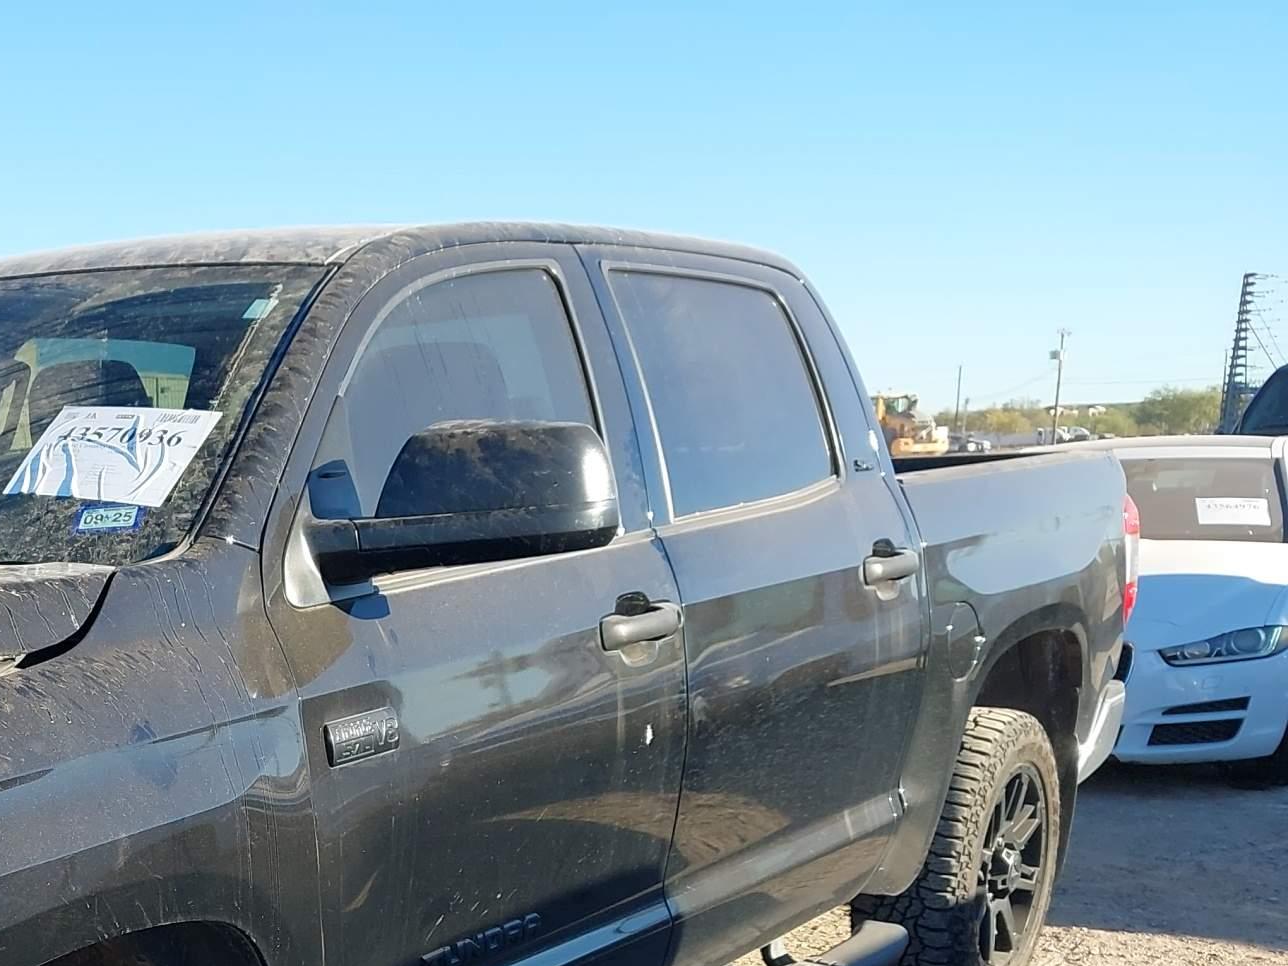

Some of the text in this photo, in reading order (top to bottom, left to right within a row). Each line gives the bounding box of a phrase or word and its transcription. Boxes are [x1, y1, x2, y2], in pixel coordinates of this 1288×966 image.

[83, 512, 133, 525] 09 25
[375, 717, 400, 745] V8
